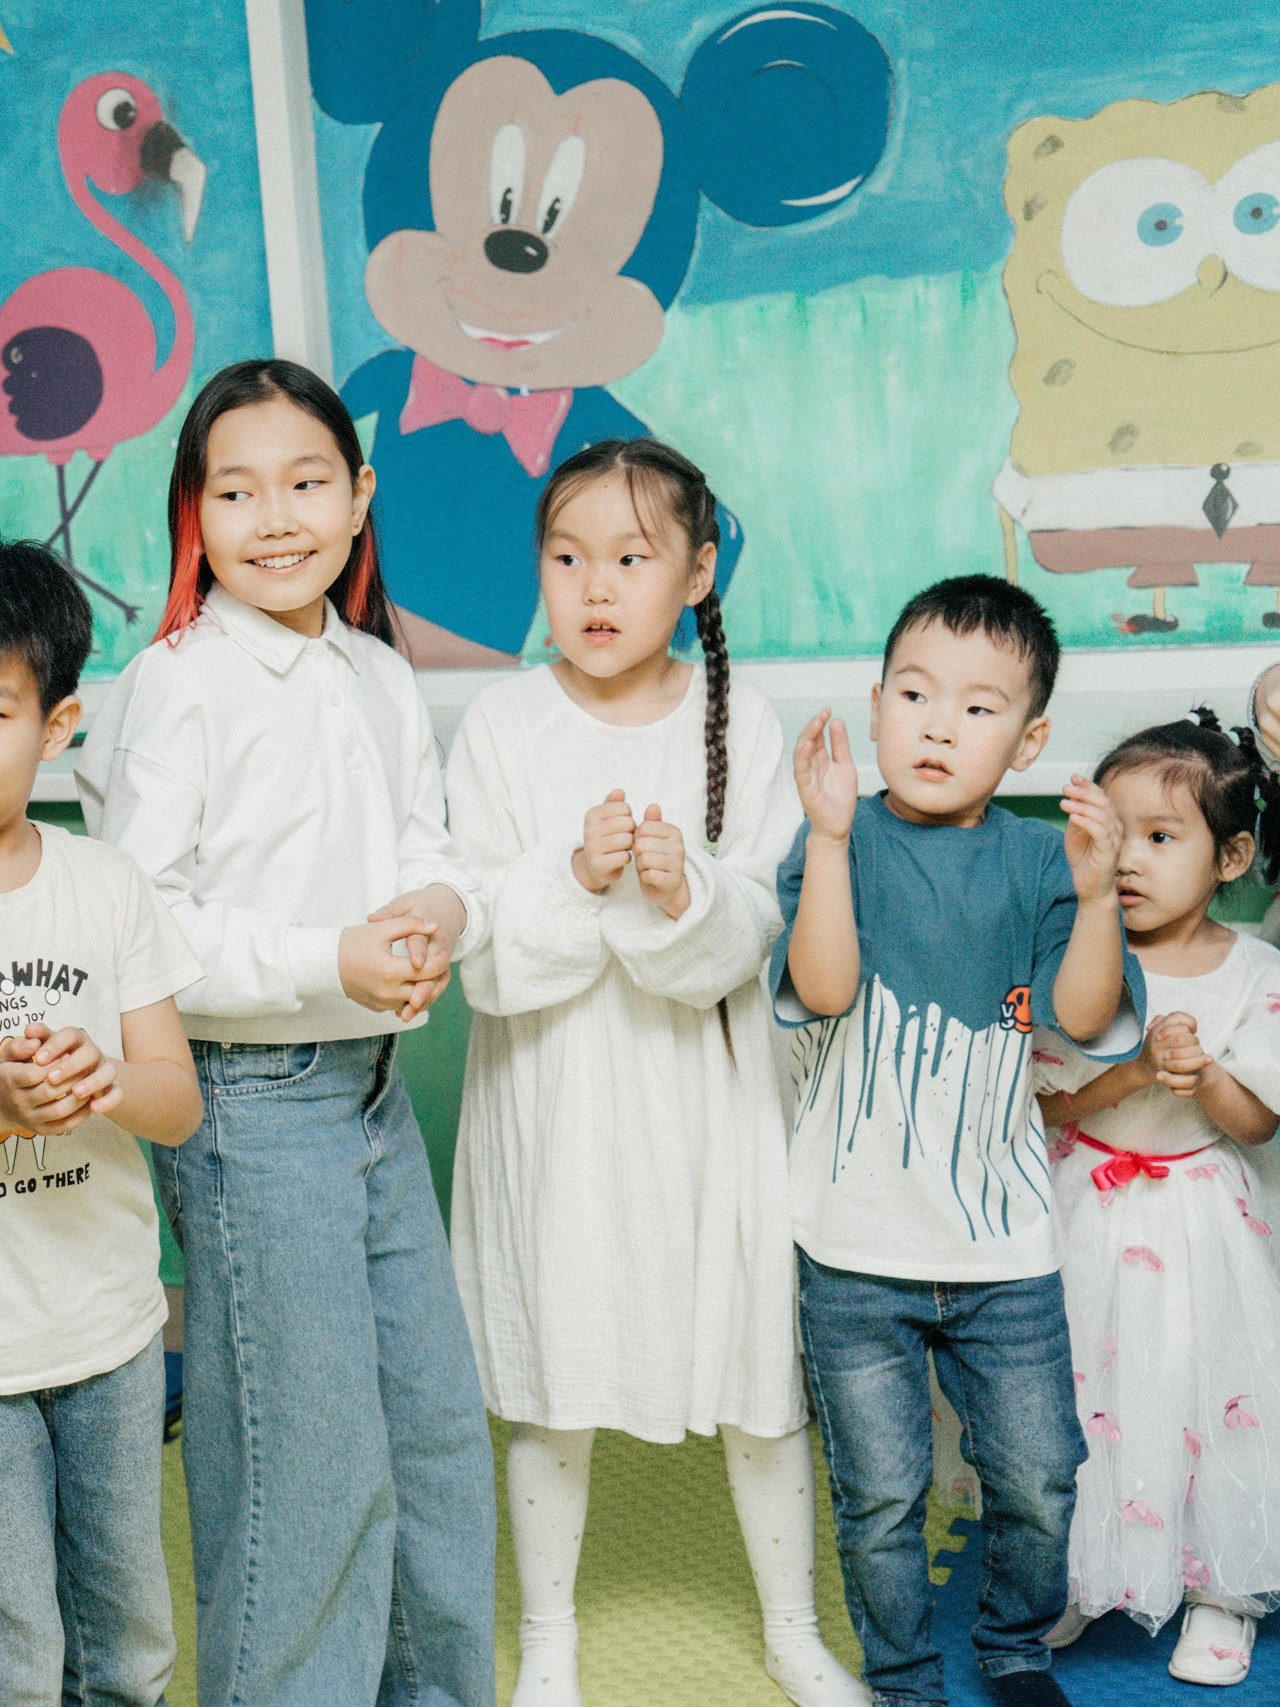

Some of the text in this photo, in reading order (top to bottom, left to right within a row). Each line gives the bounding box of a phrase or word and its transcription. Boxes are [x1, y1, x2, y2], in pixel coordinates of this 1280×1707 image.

[11, 958, 89, 997] WHAT
[24, 1010, 46, 1025] JOY
[15, 1178, 37, 1194] GO
[42, 1162, 91, 1189] THERE
